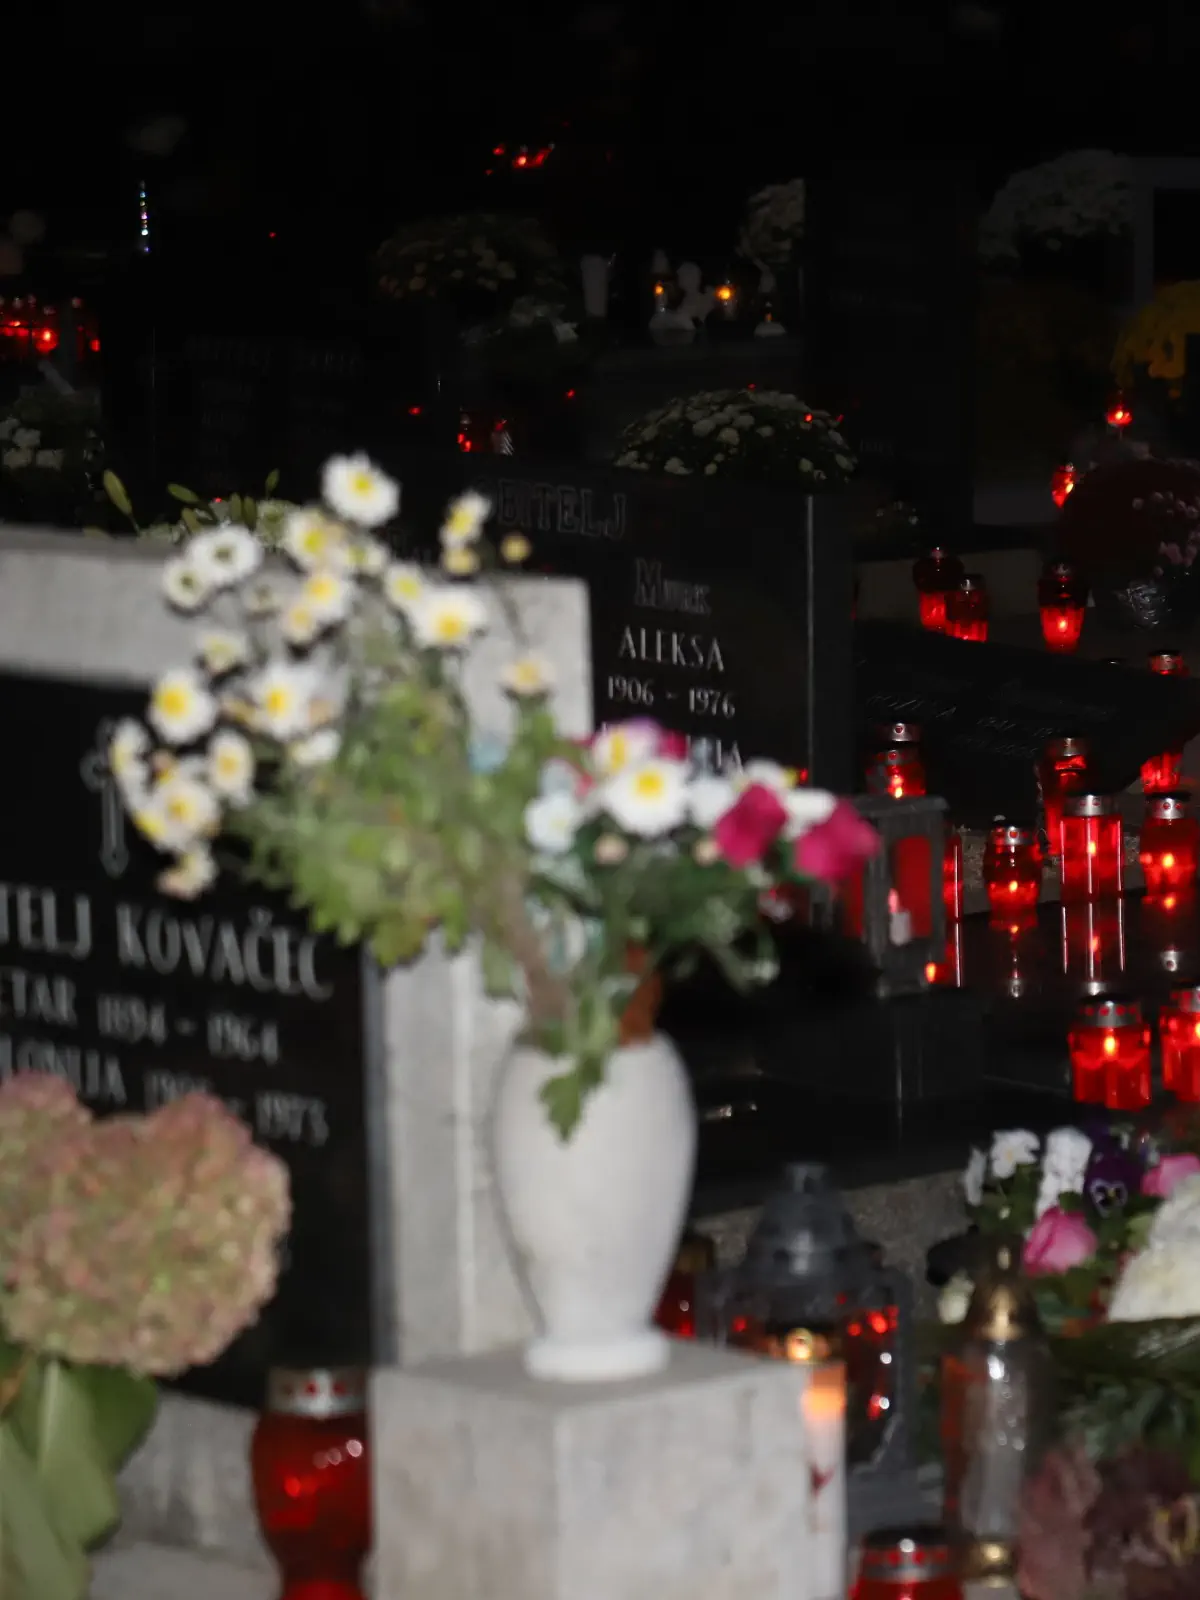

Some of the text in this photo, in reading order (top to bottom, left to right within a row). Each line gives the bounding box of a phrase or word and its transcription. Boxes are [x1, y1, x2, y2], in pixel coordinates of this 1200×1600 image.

[479, 477, 628, 541] BITELJ
[617, 624, 725, 672] ALEKSA
[607, 675, 654, 706] 1906
[688, 685, 736, 719] 1976
[115, 901, 335, 1003] KOVAČEC
